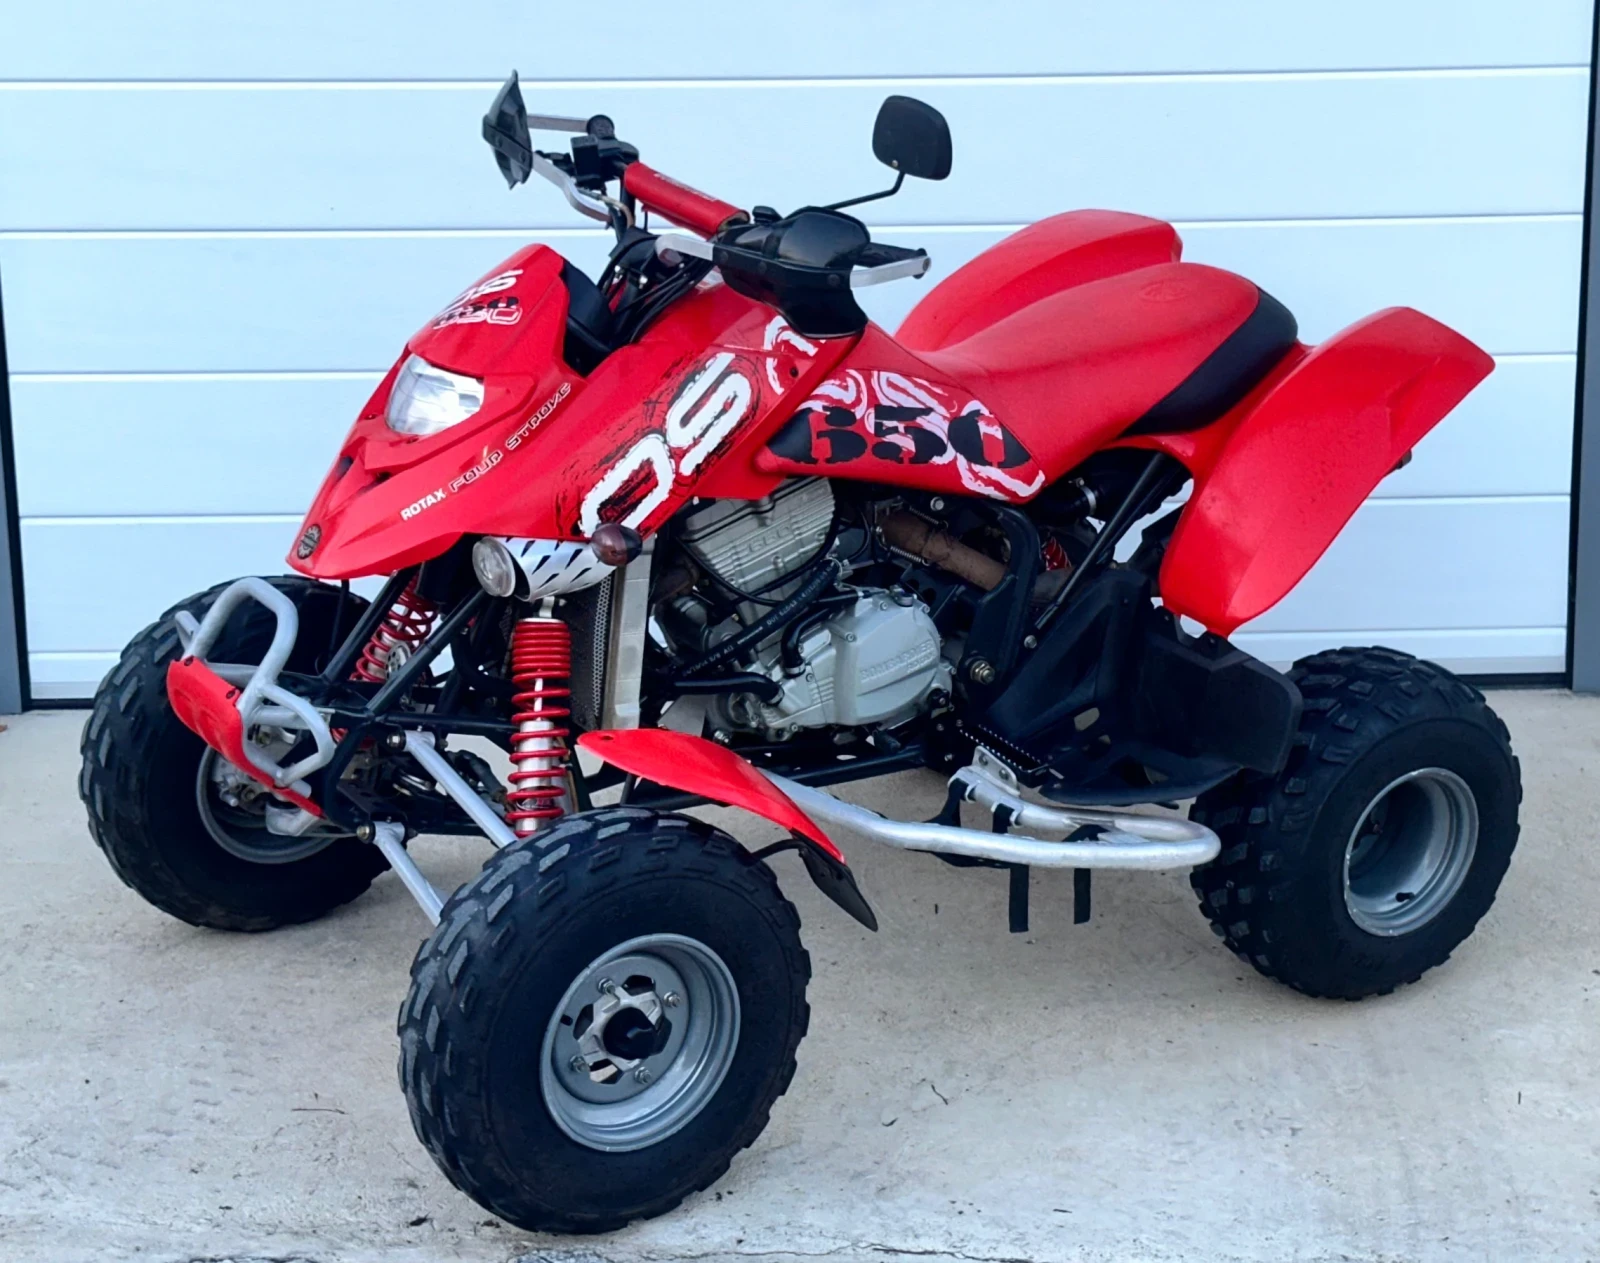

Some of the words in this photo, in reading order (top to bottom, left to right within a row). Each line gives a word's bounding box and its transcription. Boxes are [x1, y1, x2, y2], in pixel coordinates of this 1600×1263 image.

[400, 488, 447, 521] ROTAX
[449, 449, 504, 492] FOUR
[504, 382, 572, 451] STROKE
[766, 405, 1032, 468] 650
